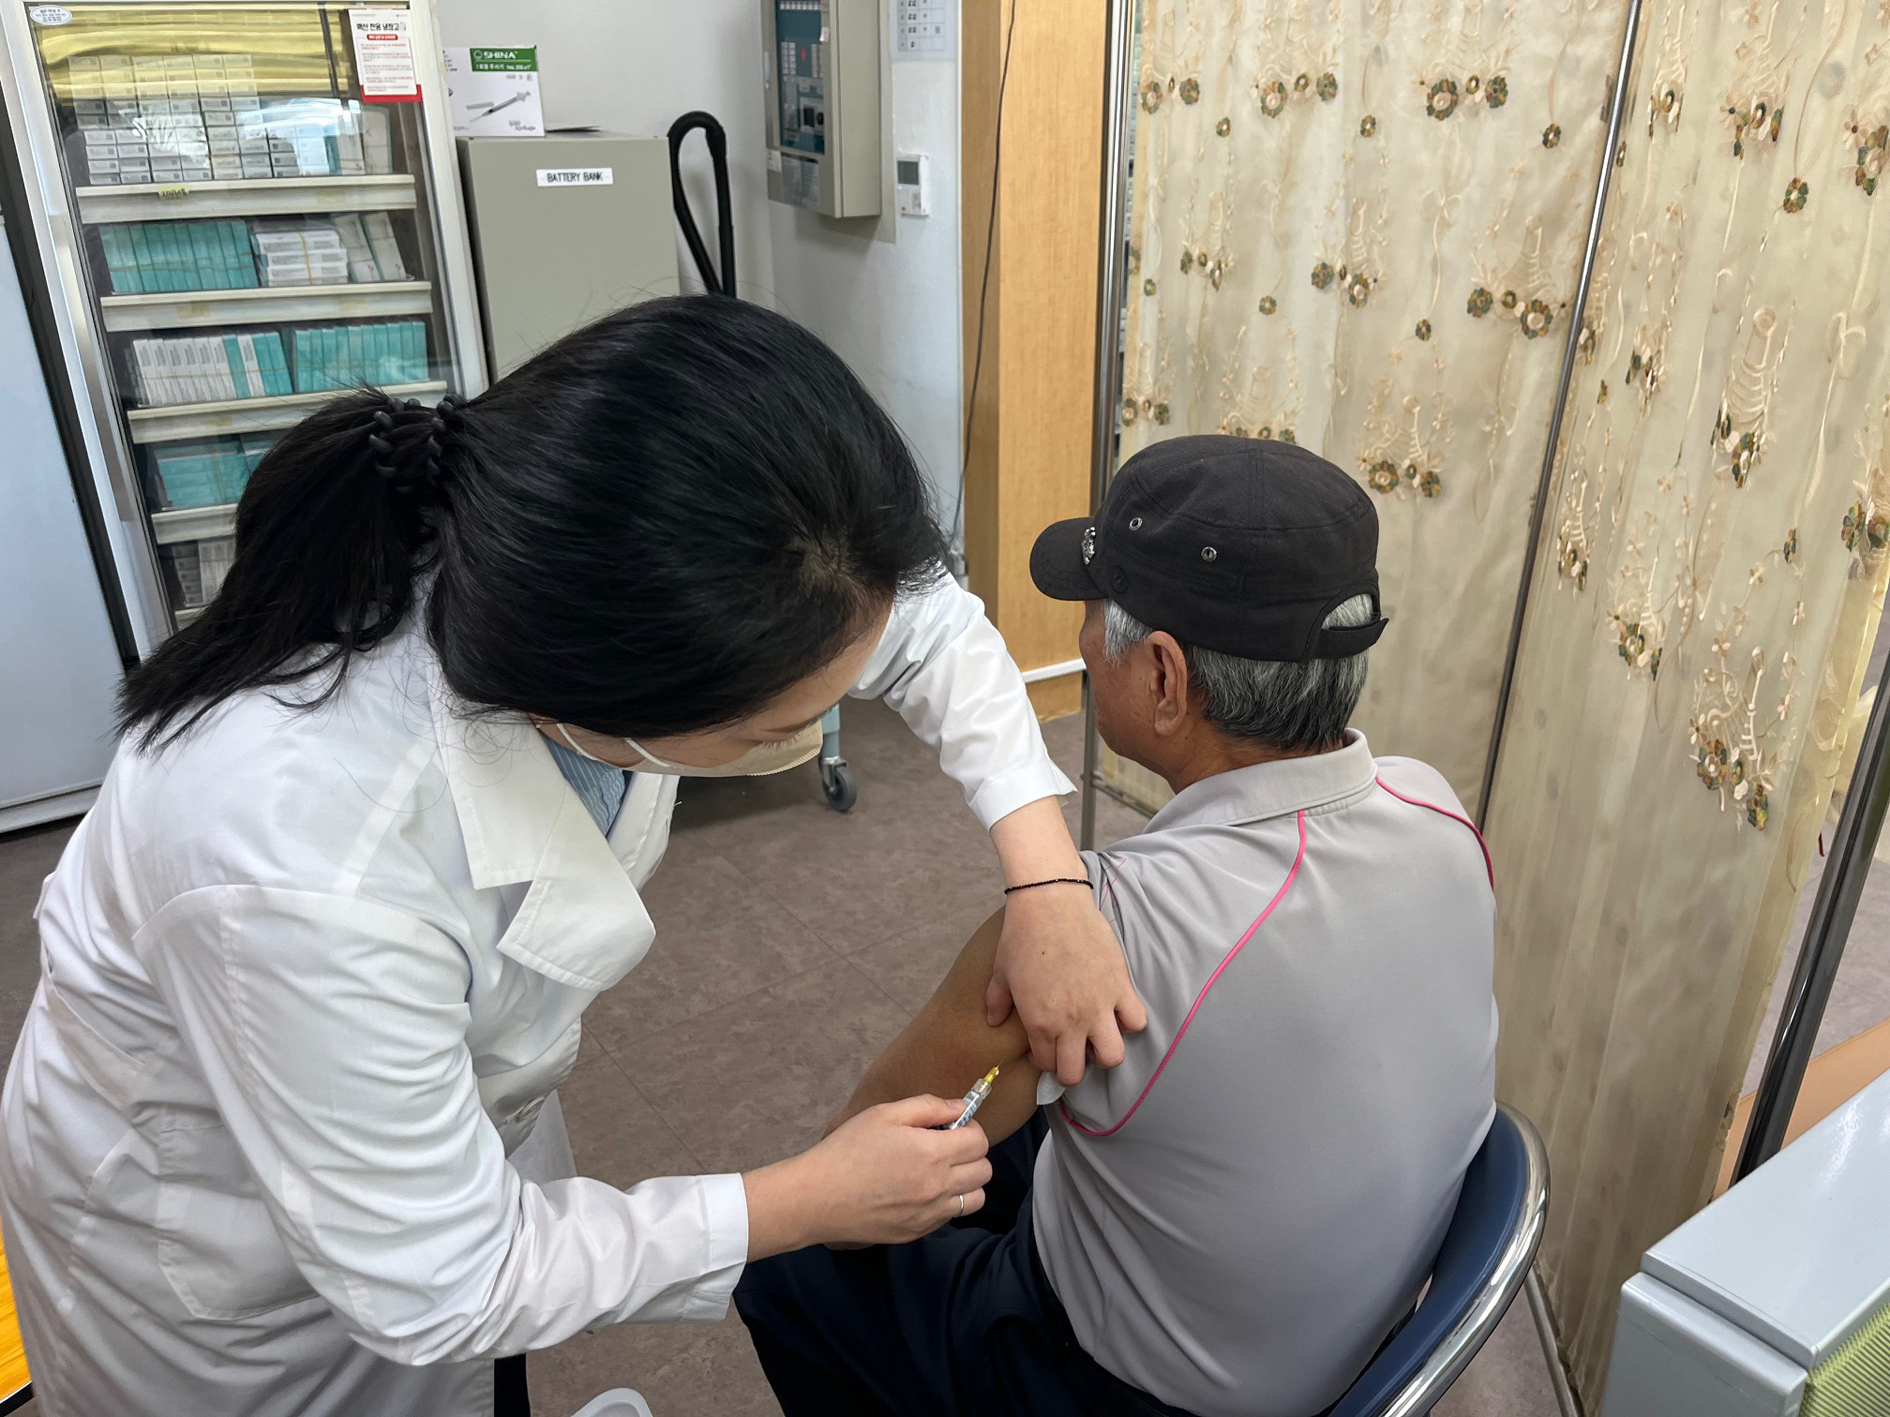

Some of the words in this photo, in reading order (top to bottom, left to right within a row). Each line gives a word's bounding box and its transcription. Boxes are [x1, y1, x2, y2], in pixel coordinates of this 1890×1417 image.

[484, 51, 516, 59] SHINA
[546, 172, 580, 183] BATTERY
[583, 171, 604, 182] BANK
